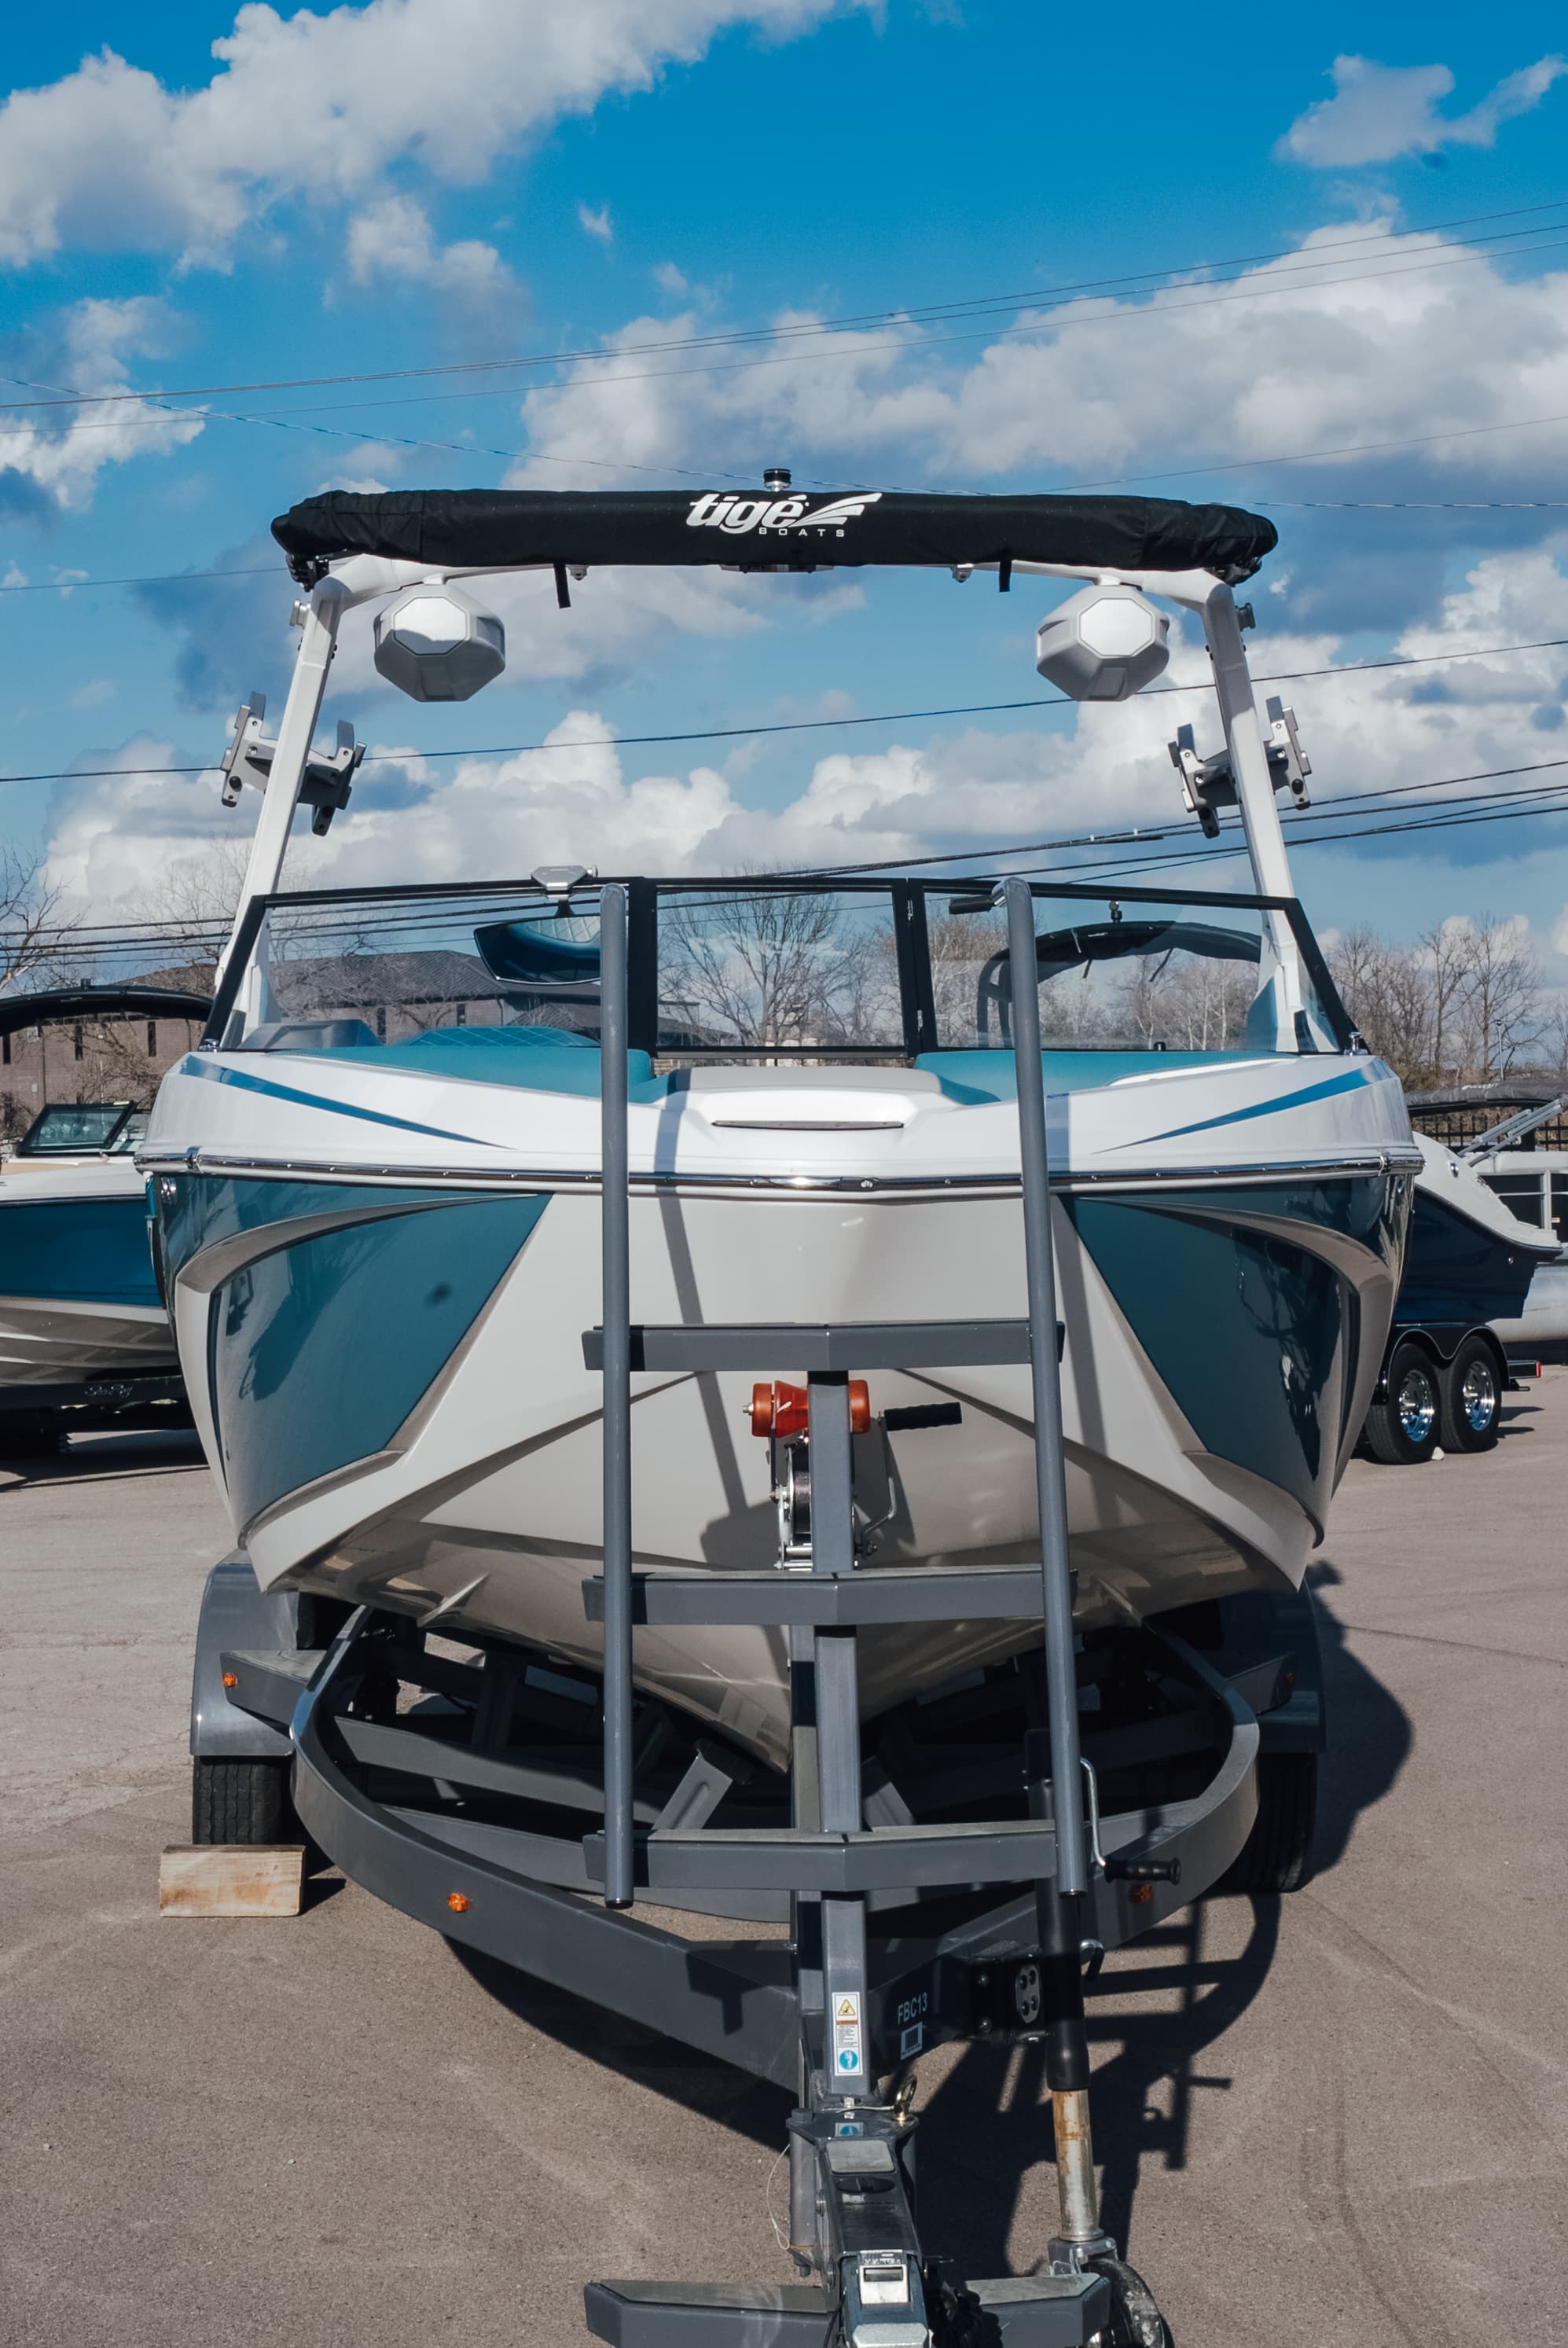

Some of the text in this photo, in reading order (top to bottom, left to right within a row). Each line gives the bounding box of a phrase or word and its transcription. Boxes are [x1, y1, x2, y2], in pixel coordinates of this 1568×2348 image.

[686, 493, 807, 534] tigé
[758, 527, 845, 537] BOATS
[898, 1992, 927, 2026] FBC13
